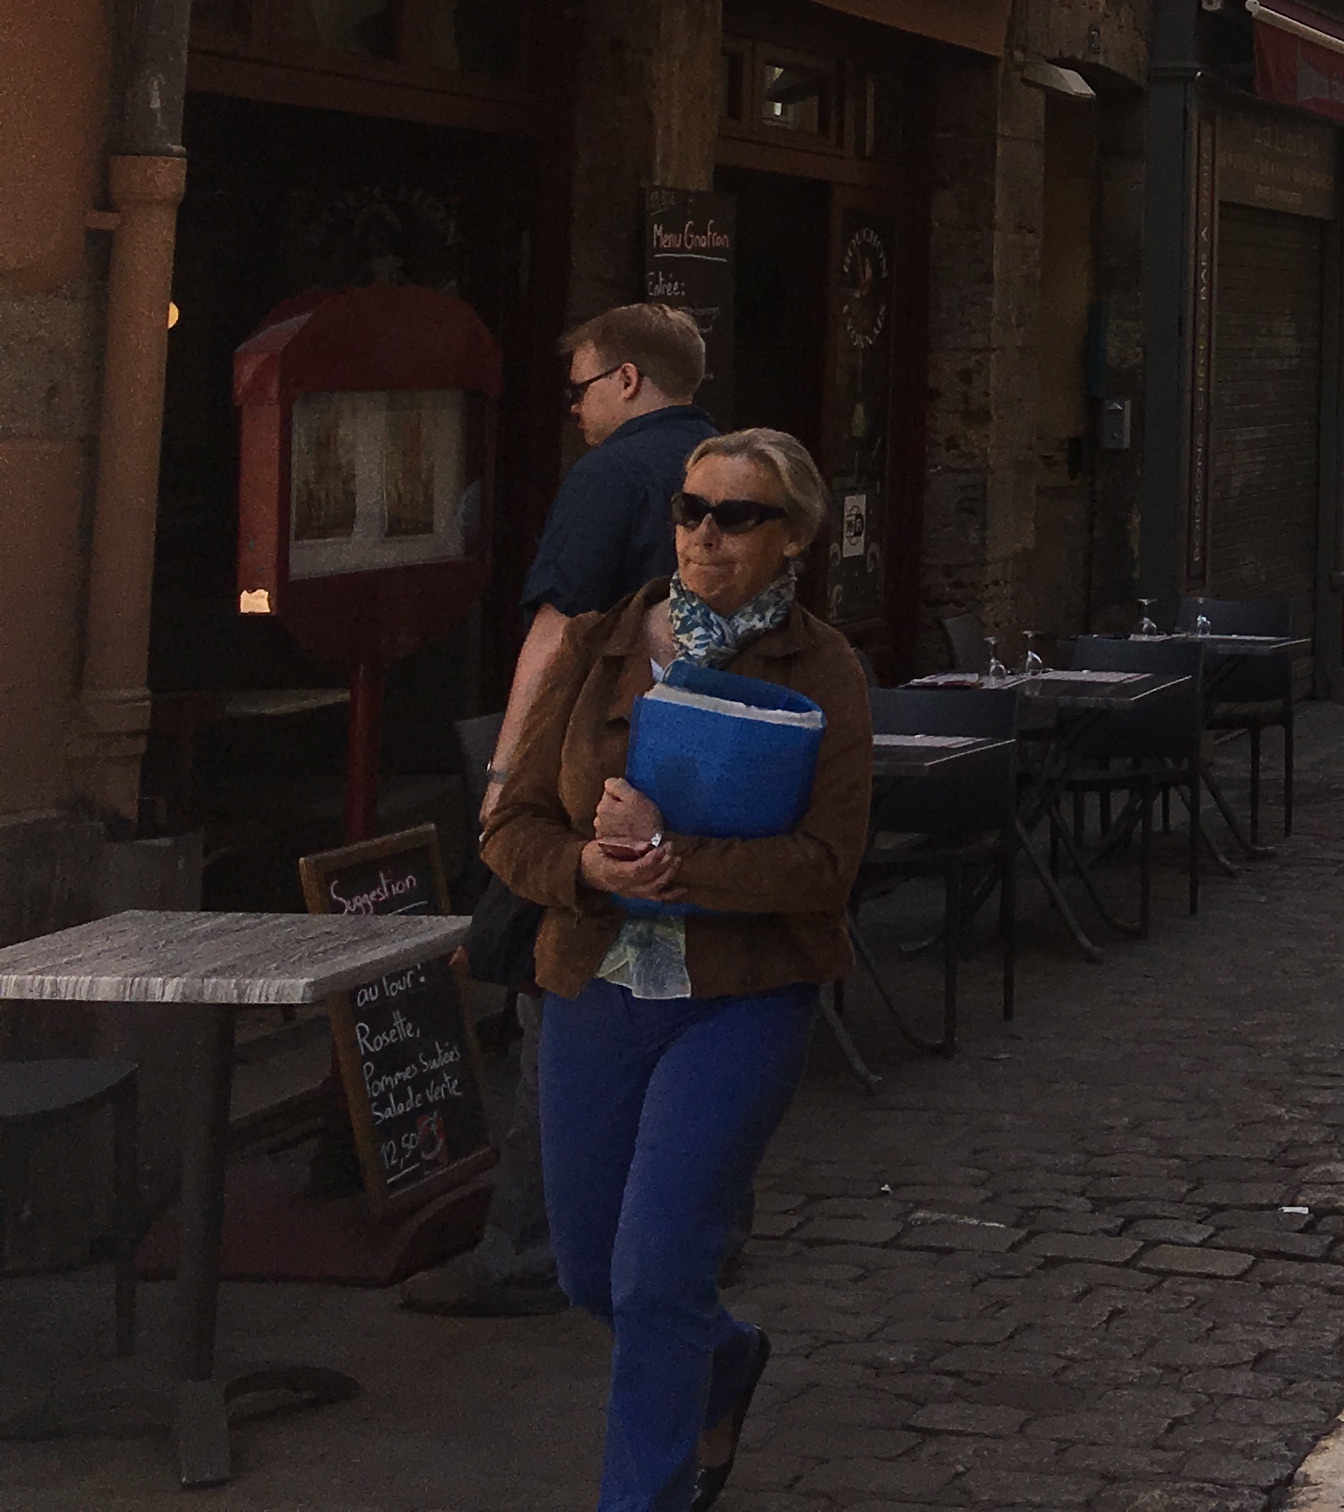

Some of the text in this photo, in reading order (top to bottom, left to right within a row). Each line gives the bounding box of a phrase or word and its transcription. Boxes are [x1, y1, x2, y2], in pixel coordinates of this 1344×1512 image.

[653, 223, 682, 248] Menu
[330, 869, 418, 915] Suggestion
[356, 983, 379, 1007] au
[362, 1061, 418, 1099] Pommes
[371, 1071, 463, 1126] Salade Verte
